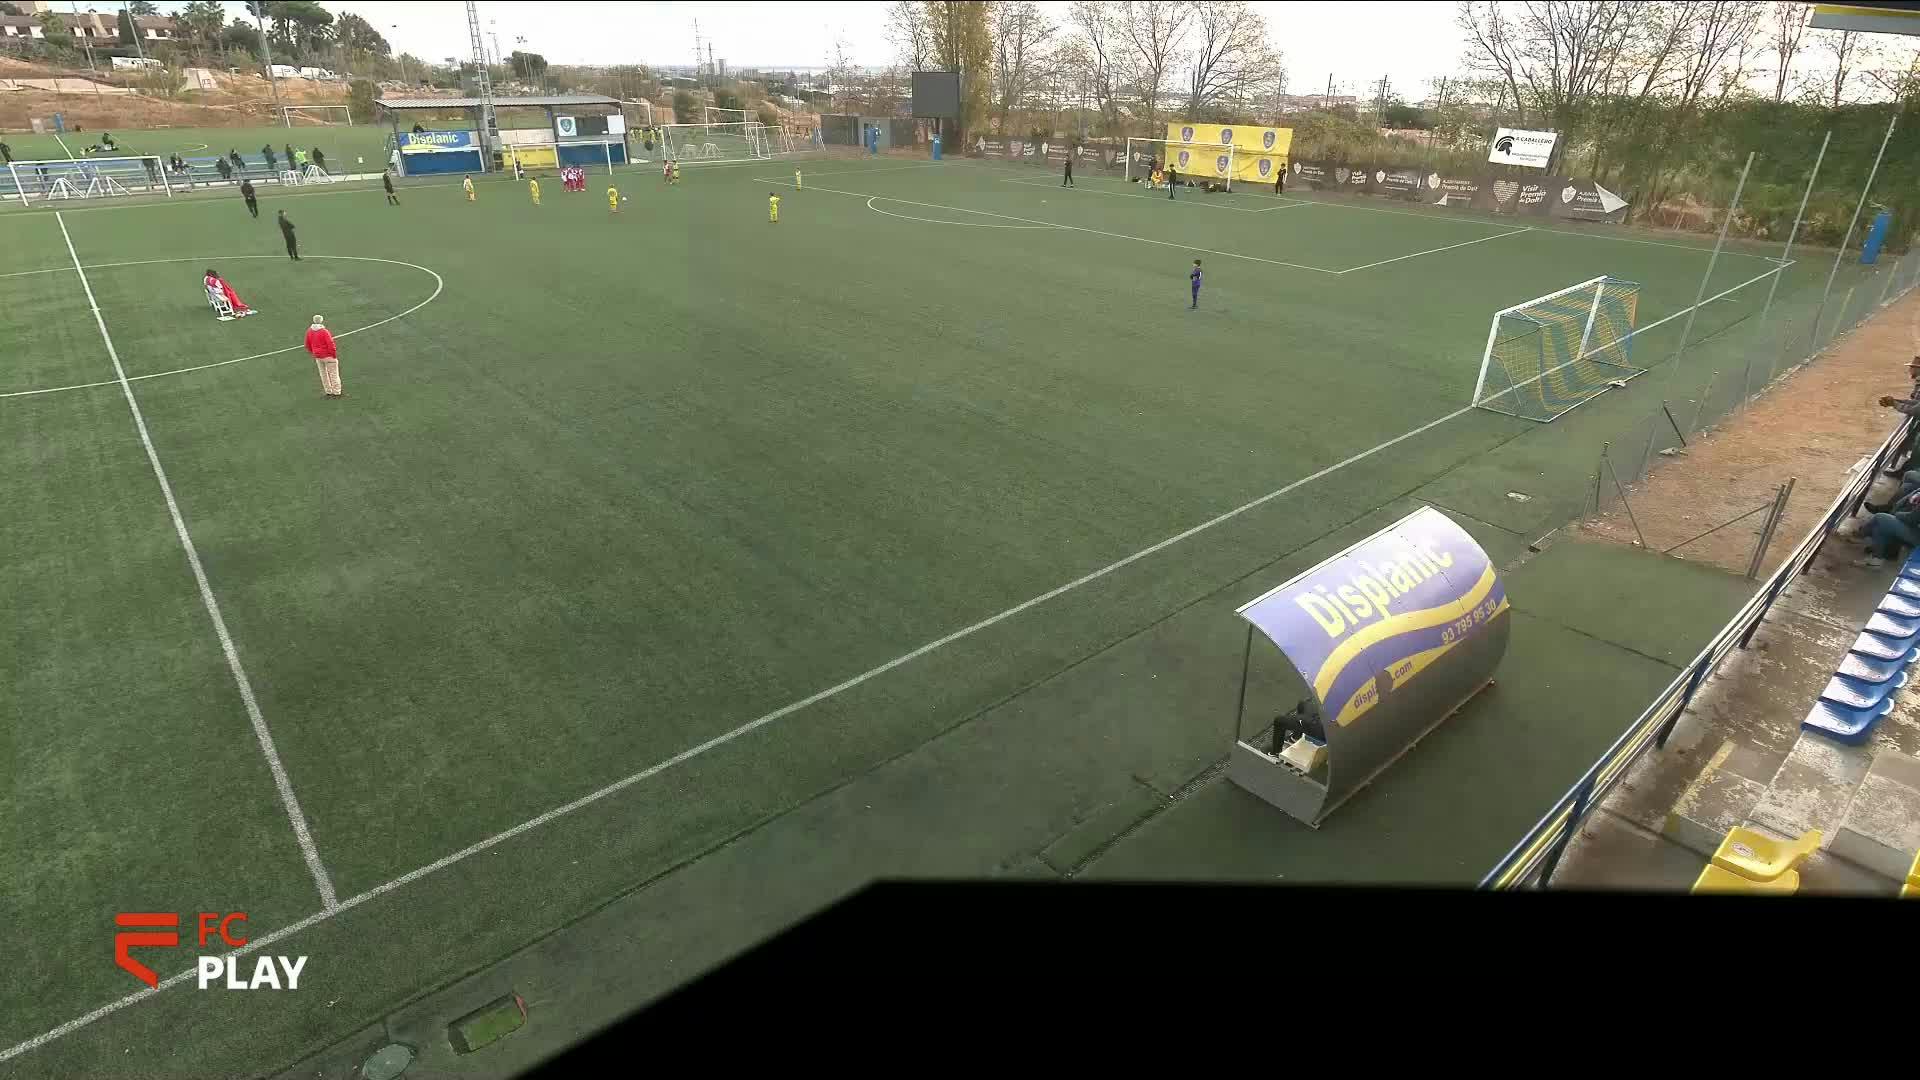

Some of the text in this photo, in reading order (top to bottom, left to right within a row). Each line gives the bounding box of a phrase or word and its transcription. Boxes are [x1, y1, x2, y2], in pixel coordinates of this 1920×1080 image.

[407, 132, 459, 145] Displanic
[1522, 184, 1539, 192] Visit
[1295, 541, 1454, 639] Displanic
[1441, 599, 1497, 644] 93 795 95 30
